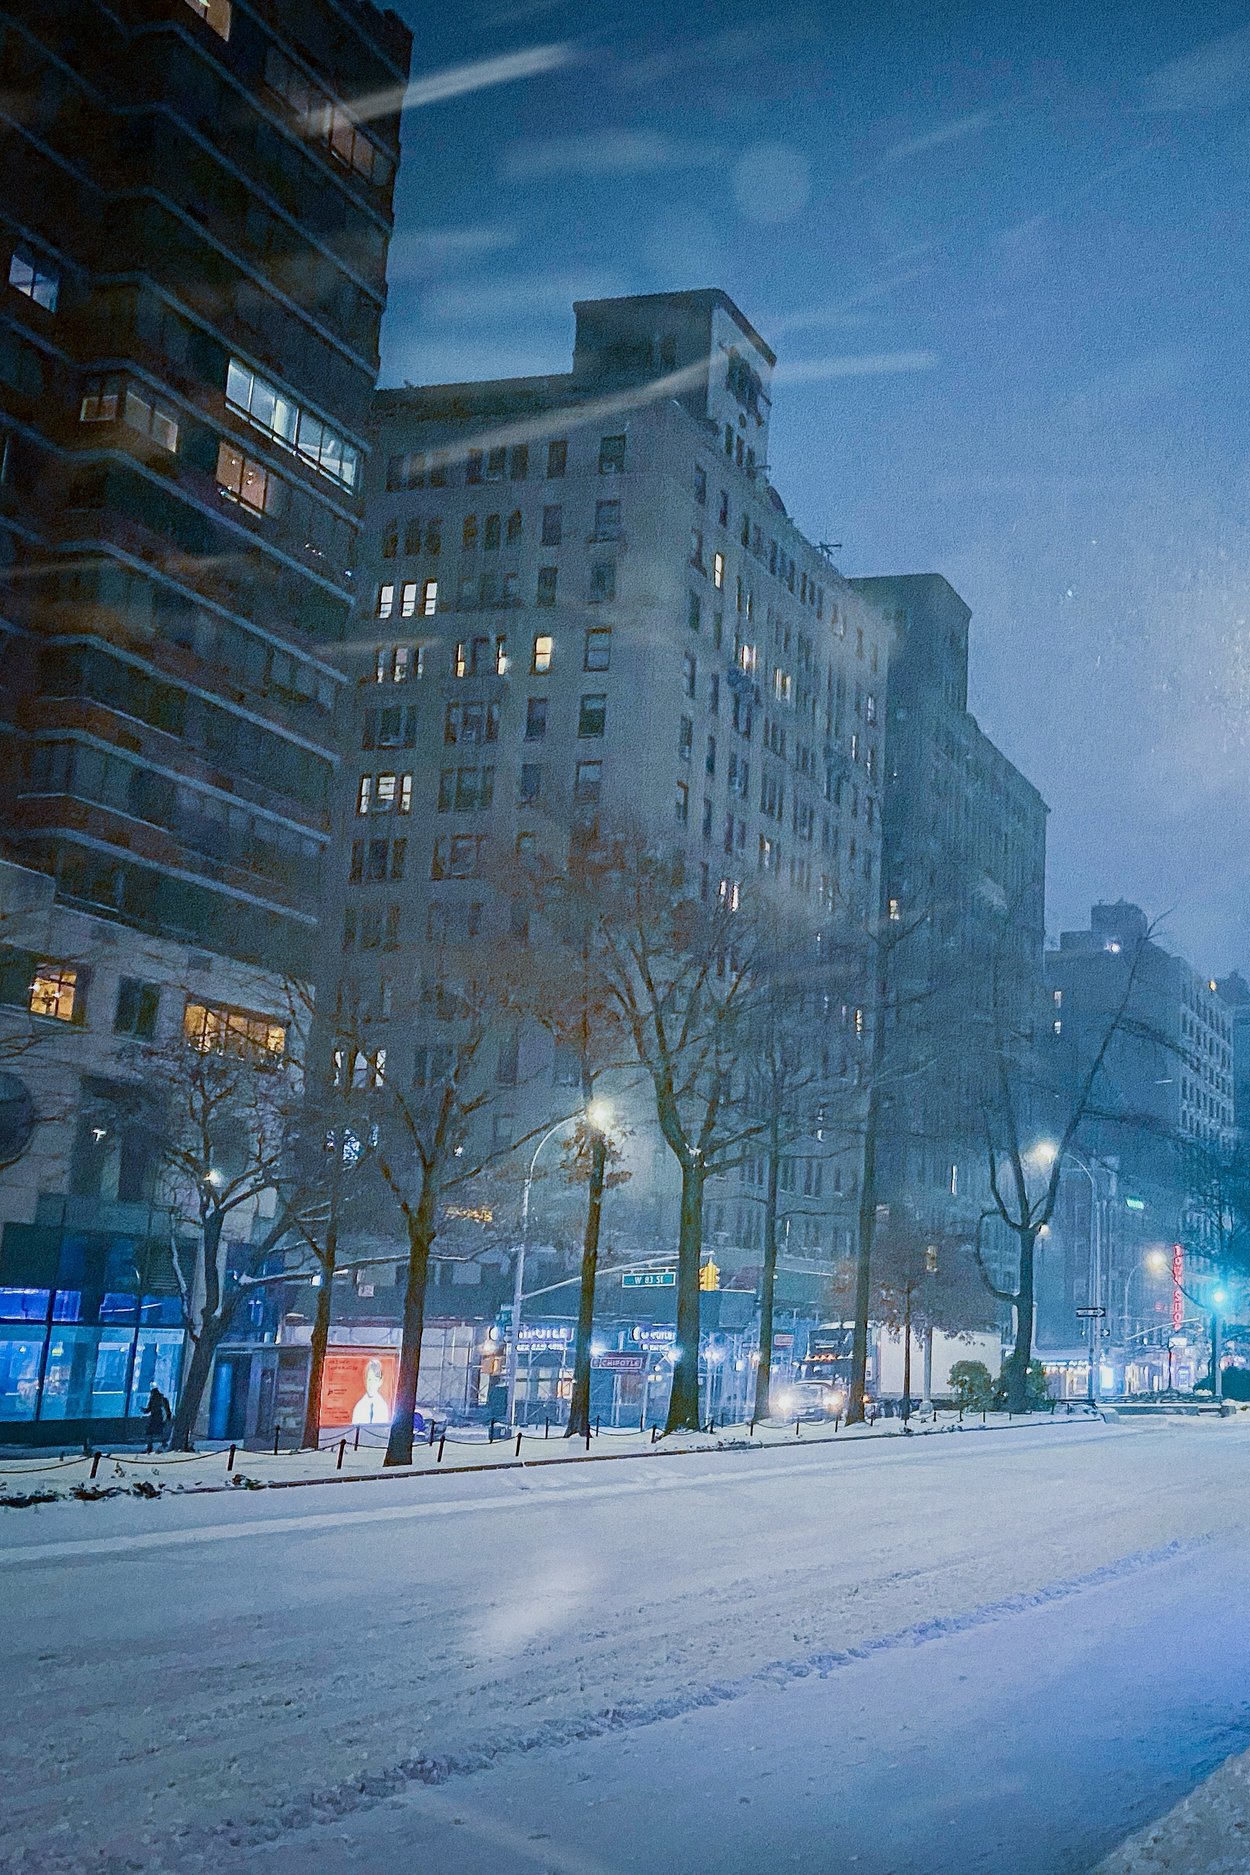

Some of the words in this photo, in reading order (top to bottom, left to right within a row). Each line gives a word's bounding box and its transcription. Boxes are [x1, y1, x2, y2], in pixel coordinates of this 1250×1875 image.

[634, 1276, 642, 1284] W
[644, 1275, 653, 1284] 83
[601, 1359, 640, 1367] CHIPOTLE
